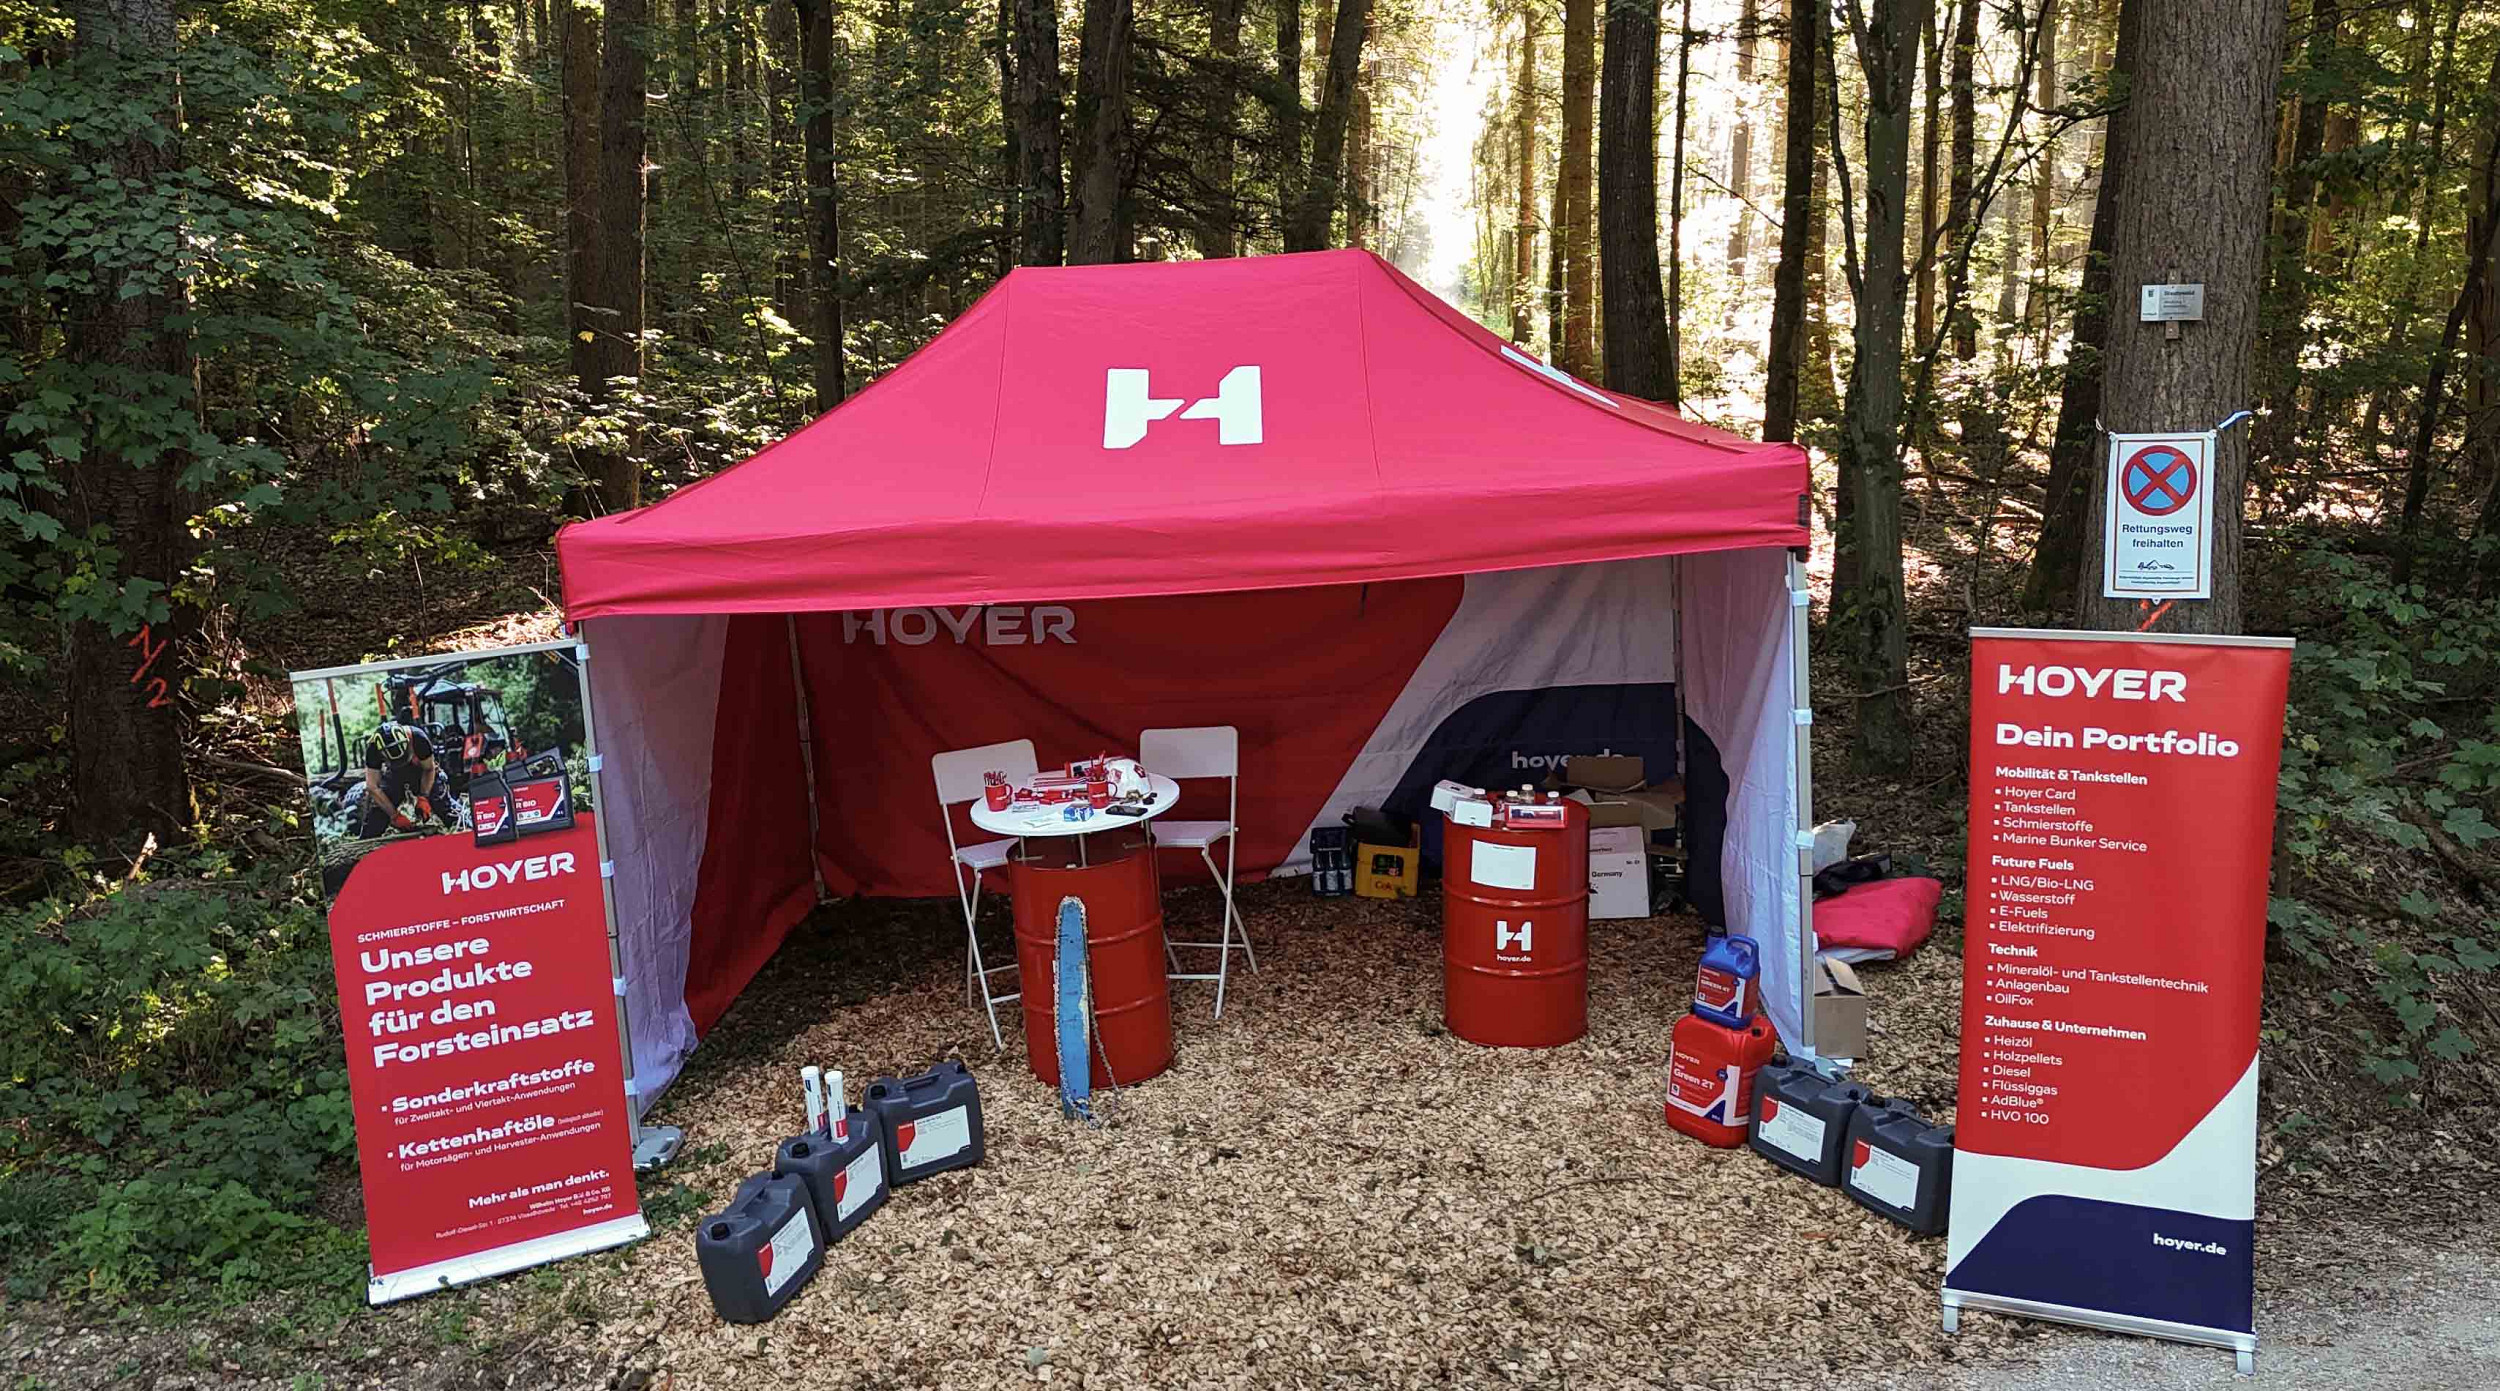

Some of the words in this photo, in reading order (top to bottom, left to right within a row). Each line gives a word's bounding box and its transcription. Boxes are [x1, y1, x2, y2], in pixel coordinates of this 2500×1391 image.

[2122, 524, 2193, 535] Rettungsweg
[2132, 538, 2184, 548] freihalten
[843, 606, 1077, 645] HOYER
[1998, 664, 2187, 702] HOYER
[1996, 723, 2074, 748] Dein
[2082, 727, 2239, 758] Portfolio
[1995, 766, 2056, 781] Mobilität
[2057, 769, 2069, 781] &
[2070, 769, 2148, 785] Tankstellen
[2004, 786, 2043, 800] Hoyer
[2045, 787, 2076, 800] Card
[2003, 801, 2075, 815] Tankstellen
[2002, 816, 2094, 832] Schmierstoffe
[2002, 833, 2047, 846] Marine
[2050, 834, 2097, 849] Bunker
[2098, 837, 2148, 852] Service
[1991, 855, 2036, 868] Future
[2038, 857, 2075, 871] Fuels
[441, 852, 576, 894] HOYER
[2000, 874, 2094, 891] LNG/Bio-LNG
[1999, 890, 2076, 905] Wasserstoff
[357, 919, 450, 943] SCHMIERSTOFFE
[461, 899, 566, 925] FORSTWIRTSCHAFT
[1999, 906, 2048, 919] E-Fuels
[1999, 920, 2096, 940] Elektrifizierung
[360, 937, 490, 973] Unsere
[1988, 943, 2038, 958] Technik
[365, 960, 533, 1005] Produkte
[1995, 978, 2070, 994] Anlagenbau
[1997, 962, 2059, 977] Mineralöl-
[2062, 968, 2087, 980] und
[2089, 969, 2208, 993] Tankstellentechnik
[1995, 993, 2034, 1006] OilFox
[369, 1010, 424, 1037] für
[430, 999, 496, 1025] den
[1985, 1015, 2040, 1030] Zuhause
[2042, 1020, 2052, 1031] &
[2055, 1021, 2147, 1041] Unternehmen
[373, 1010, 594, 1068] Forsteinsatz
[1994, 1035, 2033, 1048] Heizöl
[1993, 1050, 2063, 1066] Holzpellets
[1673, 1068, 1700, 1085] Green
[1701, 1078, 1715, 1090] 2T
[1992, 1065, 2031, 1078] Diesel
[392, 1059, 595, 1113] Sonderkraftstoffe
[1992, 1079, 2058, 1096] Flüssiggas
[394, 1116, 409, 1125] für
[410, 1108, 454, 1123] Zweitakt-
[456, 1103, 473, 1113] und
[474, 1082, 576, 1108] Viertakt-Anwendungen
[1991, 1109, 2022, 1122] HVO
[2024, 1112, 2049, 1125] 100
[398, 1114, 555, 1159] Kettenhaftöle
[400, 1162, 414, 1172] für
[416, 1151, 473, 1169] Motorsägen-
[475, 1145, 492, 1156] und
[494, 1122, 601, 1152] Harvester-Anwendungen
[468, 1192, 507, 1209] Mehr
[508, 1186, 530, 1200] als
[531, 1180, 563, 1195] man
[564, 1169, 610, 1186] denkt.
[2153, 1233, 2227, 1256] hoyer.de
